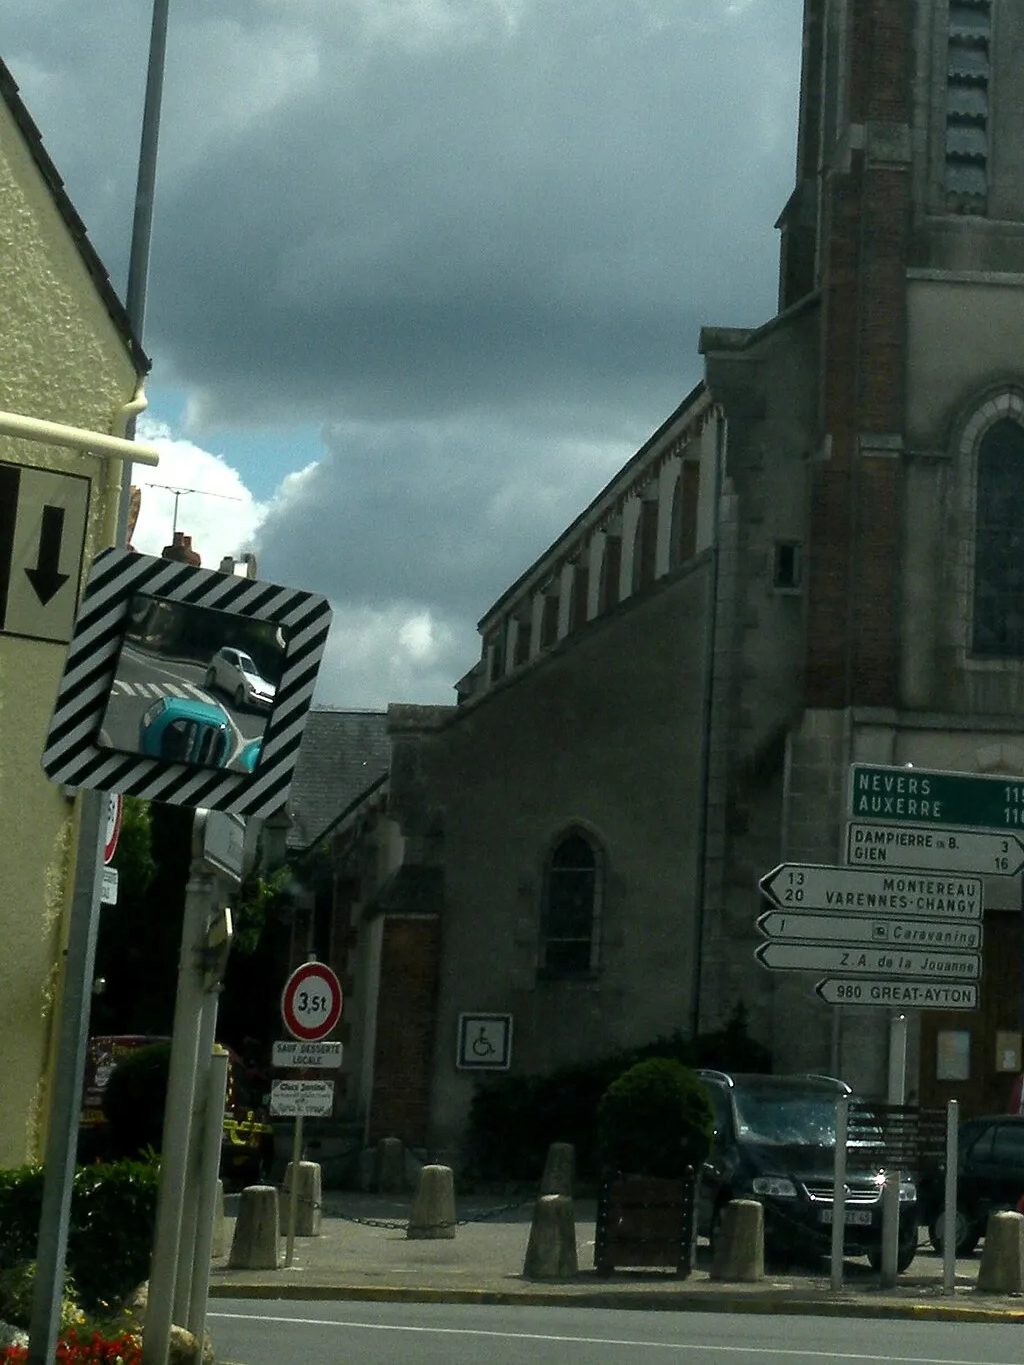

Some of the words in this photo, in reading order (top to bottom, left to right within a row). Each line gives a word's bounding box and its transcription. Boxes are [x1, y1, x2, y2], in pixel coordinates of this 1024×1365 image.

[859, 773, 932, 795] NEVERS
[859, 795, 943, 818] AUXERRE
[855, 830, 933, 848] DAMPIERRE
[1001, 840, 1009, 853] 3
[854, 846, 887, 860] GIEN
[994, 857, 1009, 870] 16
[788, 872, 805, 885] 13
[883, 878, 975, 897] MONTEREAU
[785, 889, 804, 901] 20
[826, 890, 976, 914] VARENNES-CHANGY
[893, 925, 976, 946] Caravaning
[878, 955, 893, 968] de
[898, 956, 912, 969] la
[920, 957, 975, 973] Jouanne
[298, 992, 327, 1014] 3,5t
[836, 985, 862, 999] 980
[870, 987, 972, 1003] GREAT-AYTON
[277, 1043, 297, 1053] SAUF
[300, 1044, 340, 1055] DESSERTE
[292, 1055, 323, 1065] LOCALE
